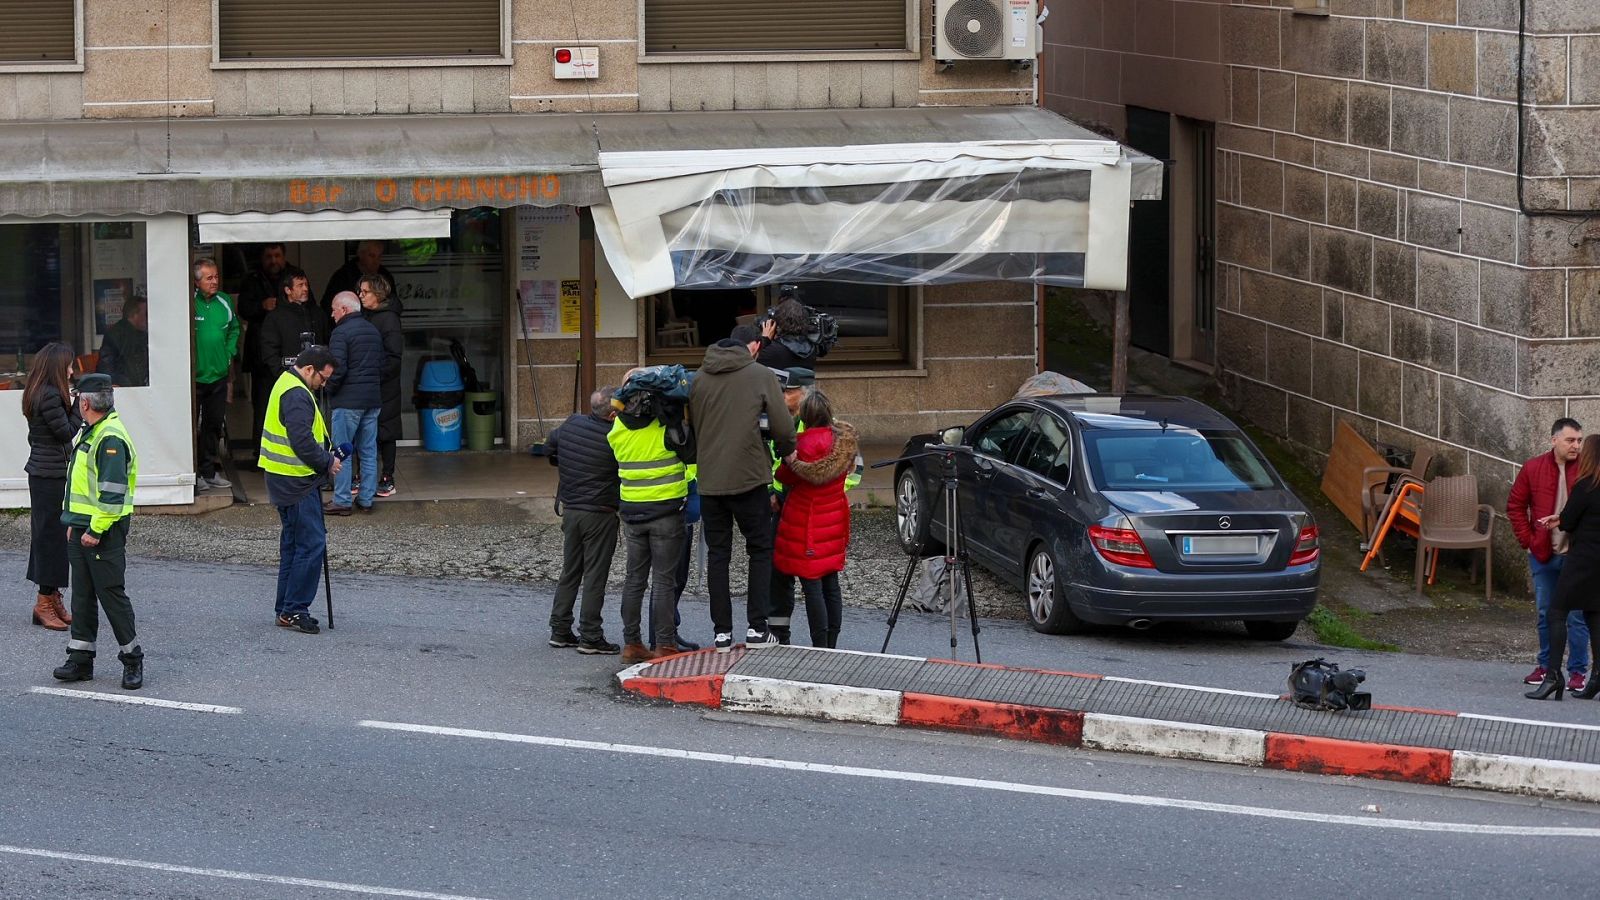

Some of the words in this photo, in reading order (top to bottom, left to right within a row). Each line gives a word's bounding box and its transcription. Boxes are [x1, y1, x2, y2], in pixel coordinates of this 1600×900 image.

[289, 179, 344, 204] Bar
[375, 178, 397, 202] O
[412, 174, 560, 202] CHANCHO
